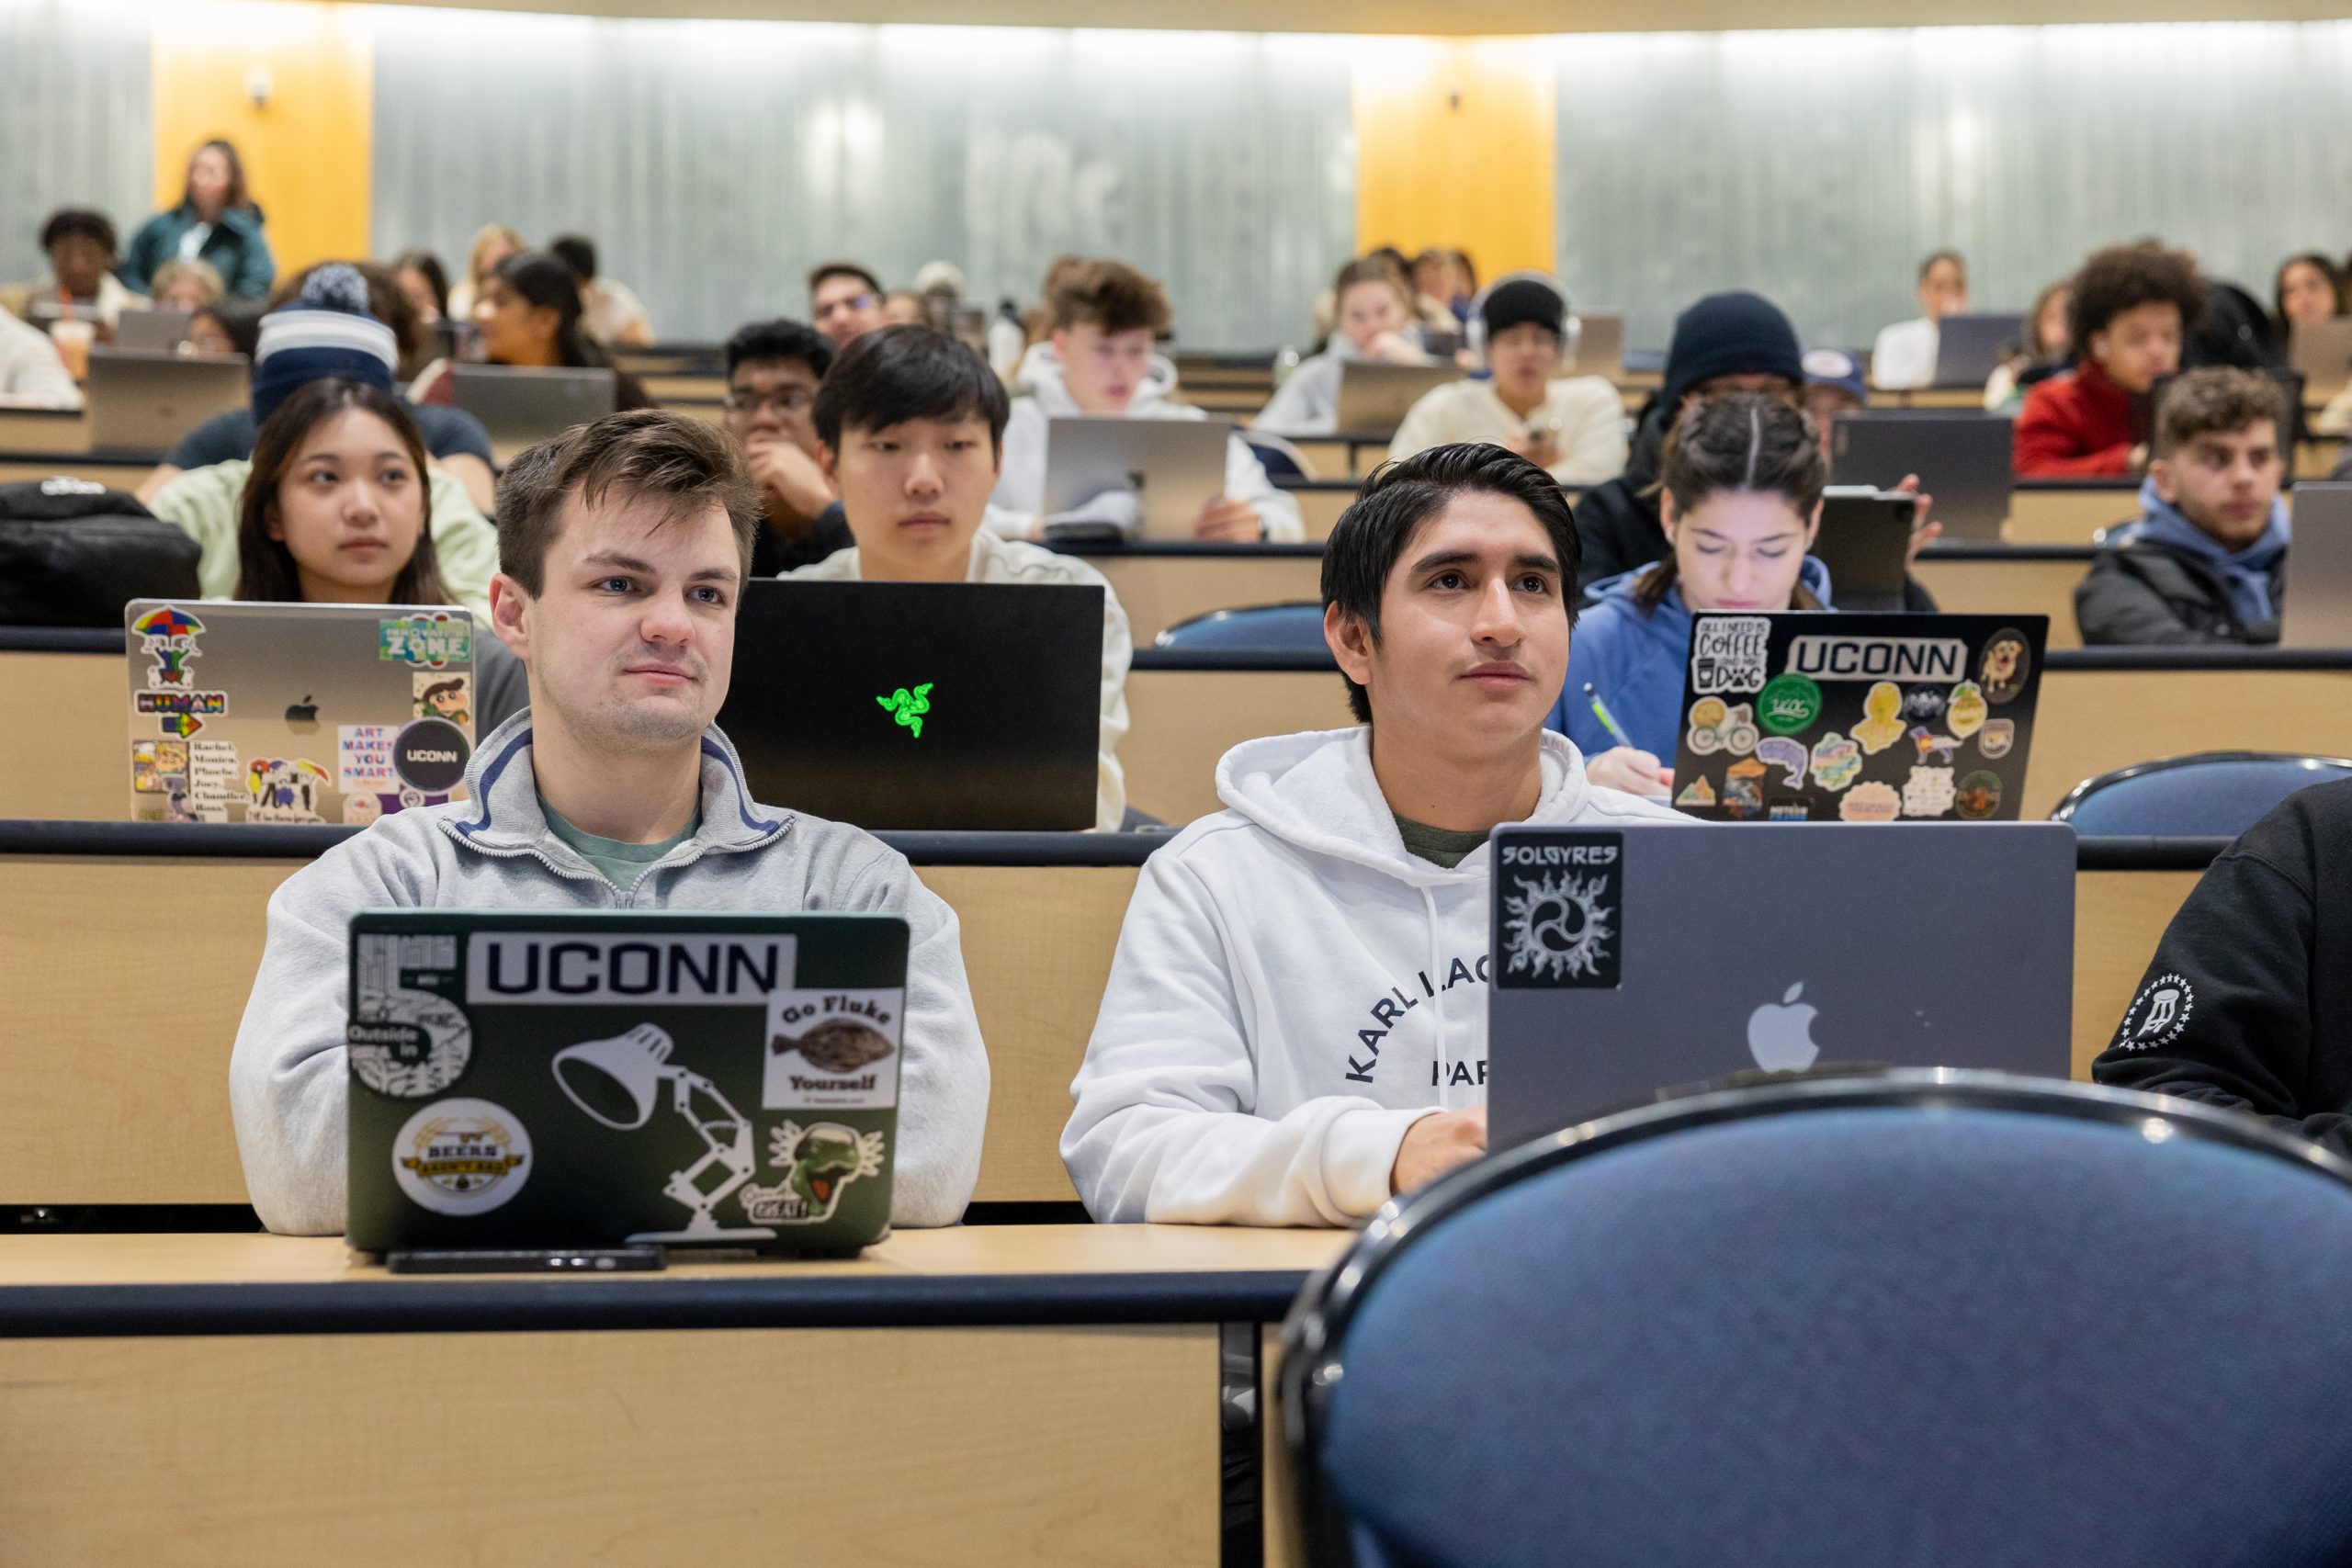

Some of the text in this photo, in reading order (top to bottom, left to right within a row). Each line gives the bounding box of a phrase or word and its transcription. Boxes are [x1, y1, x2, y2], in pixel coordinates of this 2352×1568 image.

[1728, 621, 1755, 632] NEED
[1700, 634, 1762, 655] COFFEE
[1796, 641, 1958, 675] UCONN
[138, 694, 224, 713] HUMAN
[354, 727, 384, 738] ART
[354, 753, 385, 764] YOU
[407, 750, 458, 762] UCONN
[344, 766, 394, 777] SMART
[488, 942, 778, 995] UCONN
[783, 995, 890, 1024] Go Fluke
[348, 1025, 419, 1042] Outside
[1345, 987, 1419, 1083] KARL
[400, 1043, 419, 1057] in
[790, 1074, 876, 1090] Yourself
[429, 1145, 497, 1157] BEERS
